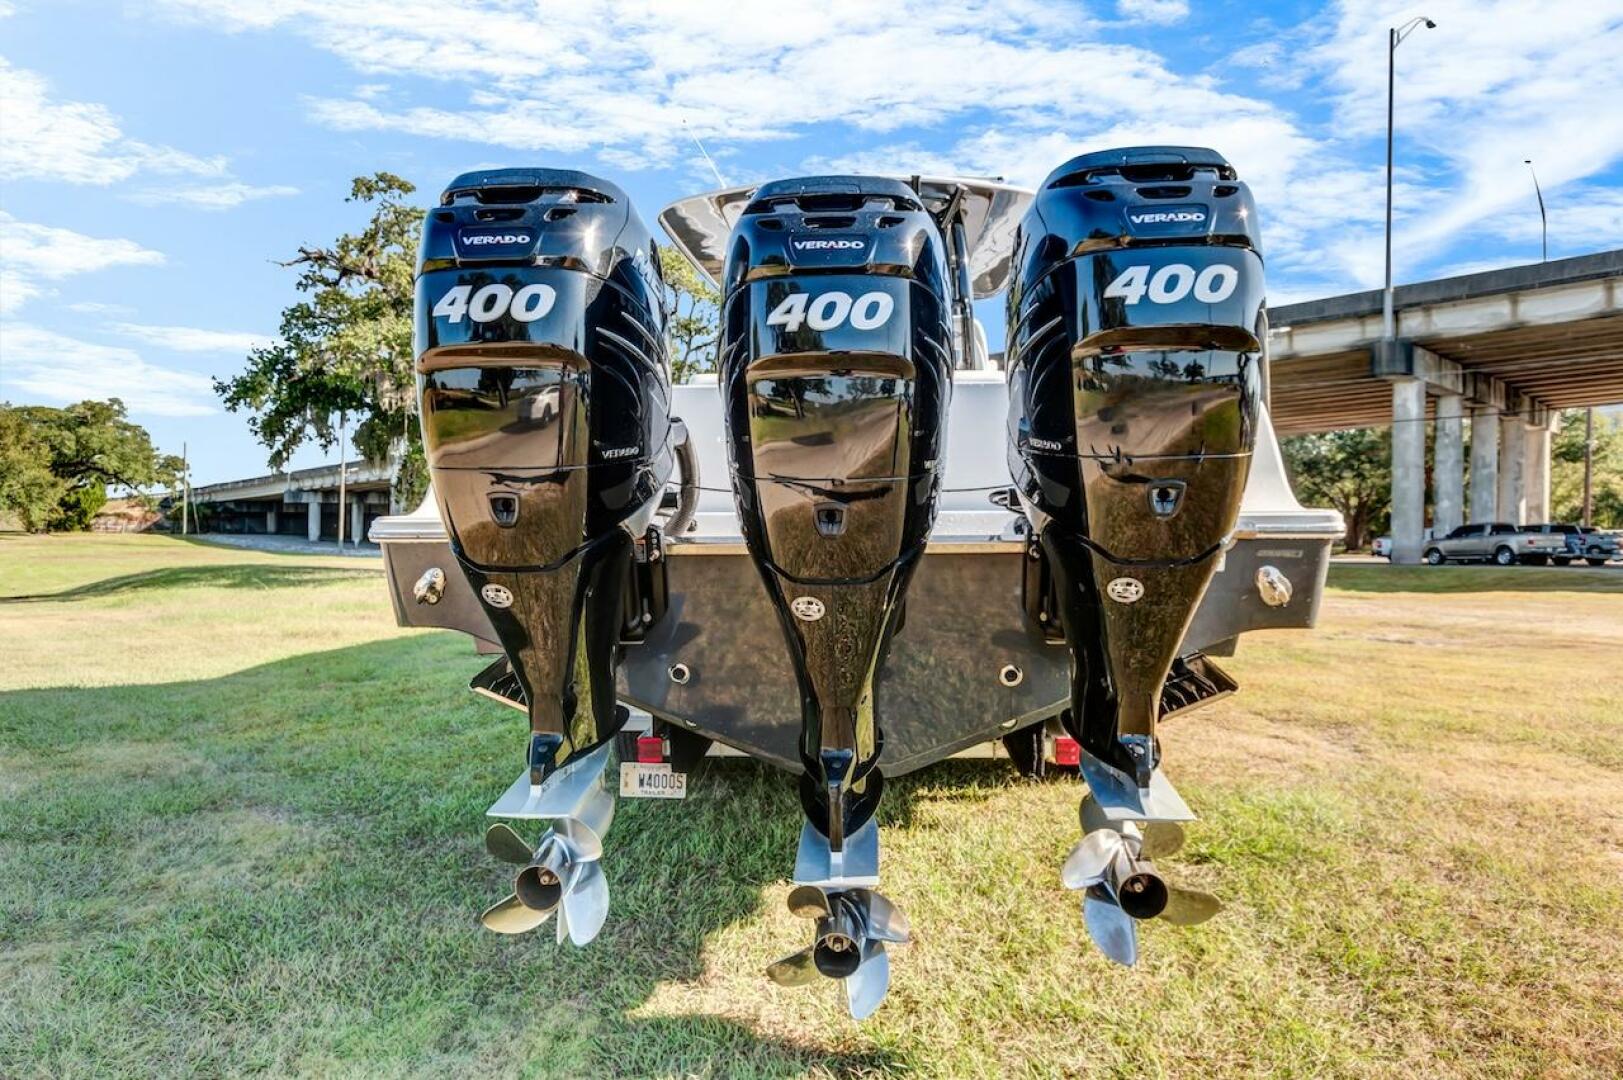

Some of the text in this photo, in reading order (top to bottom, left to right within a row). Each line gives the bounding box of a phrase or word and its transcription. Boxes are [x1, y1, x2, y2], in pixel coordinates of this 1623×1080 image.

[1130, 212, 1206, 224] VERADO
[462, 234, 531, 246] VERADO
[793, 240, 865, 250] VERADO
[1103, 263, 1239, 305] 400
[432, 283, 558, 324] 400
[766, 291, 895, 333] 400
